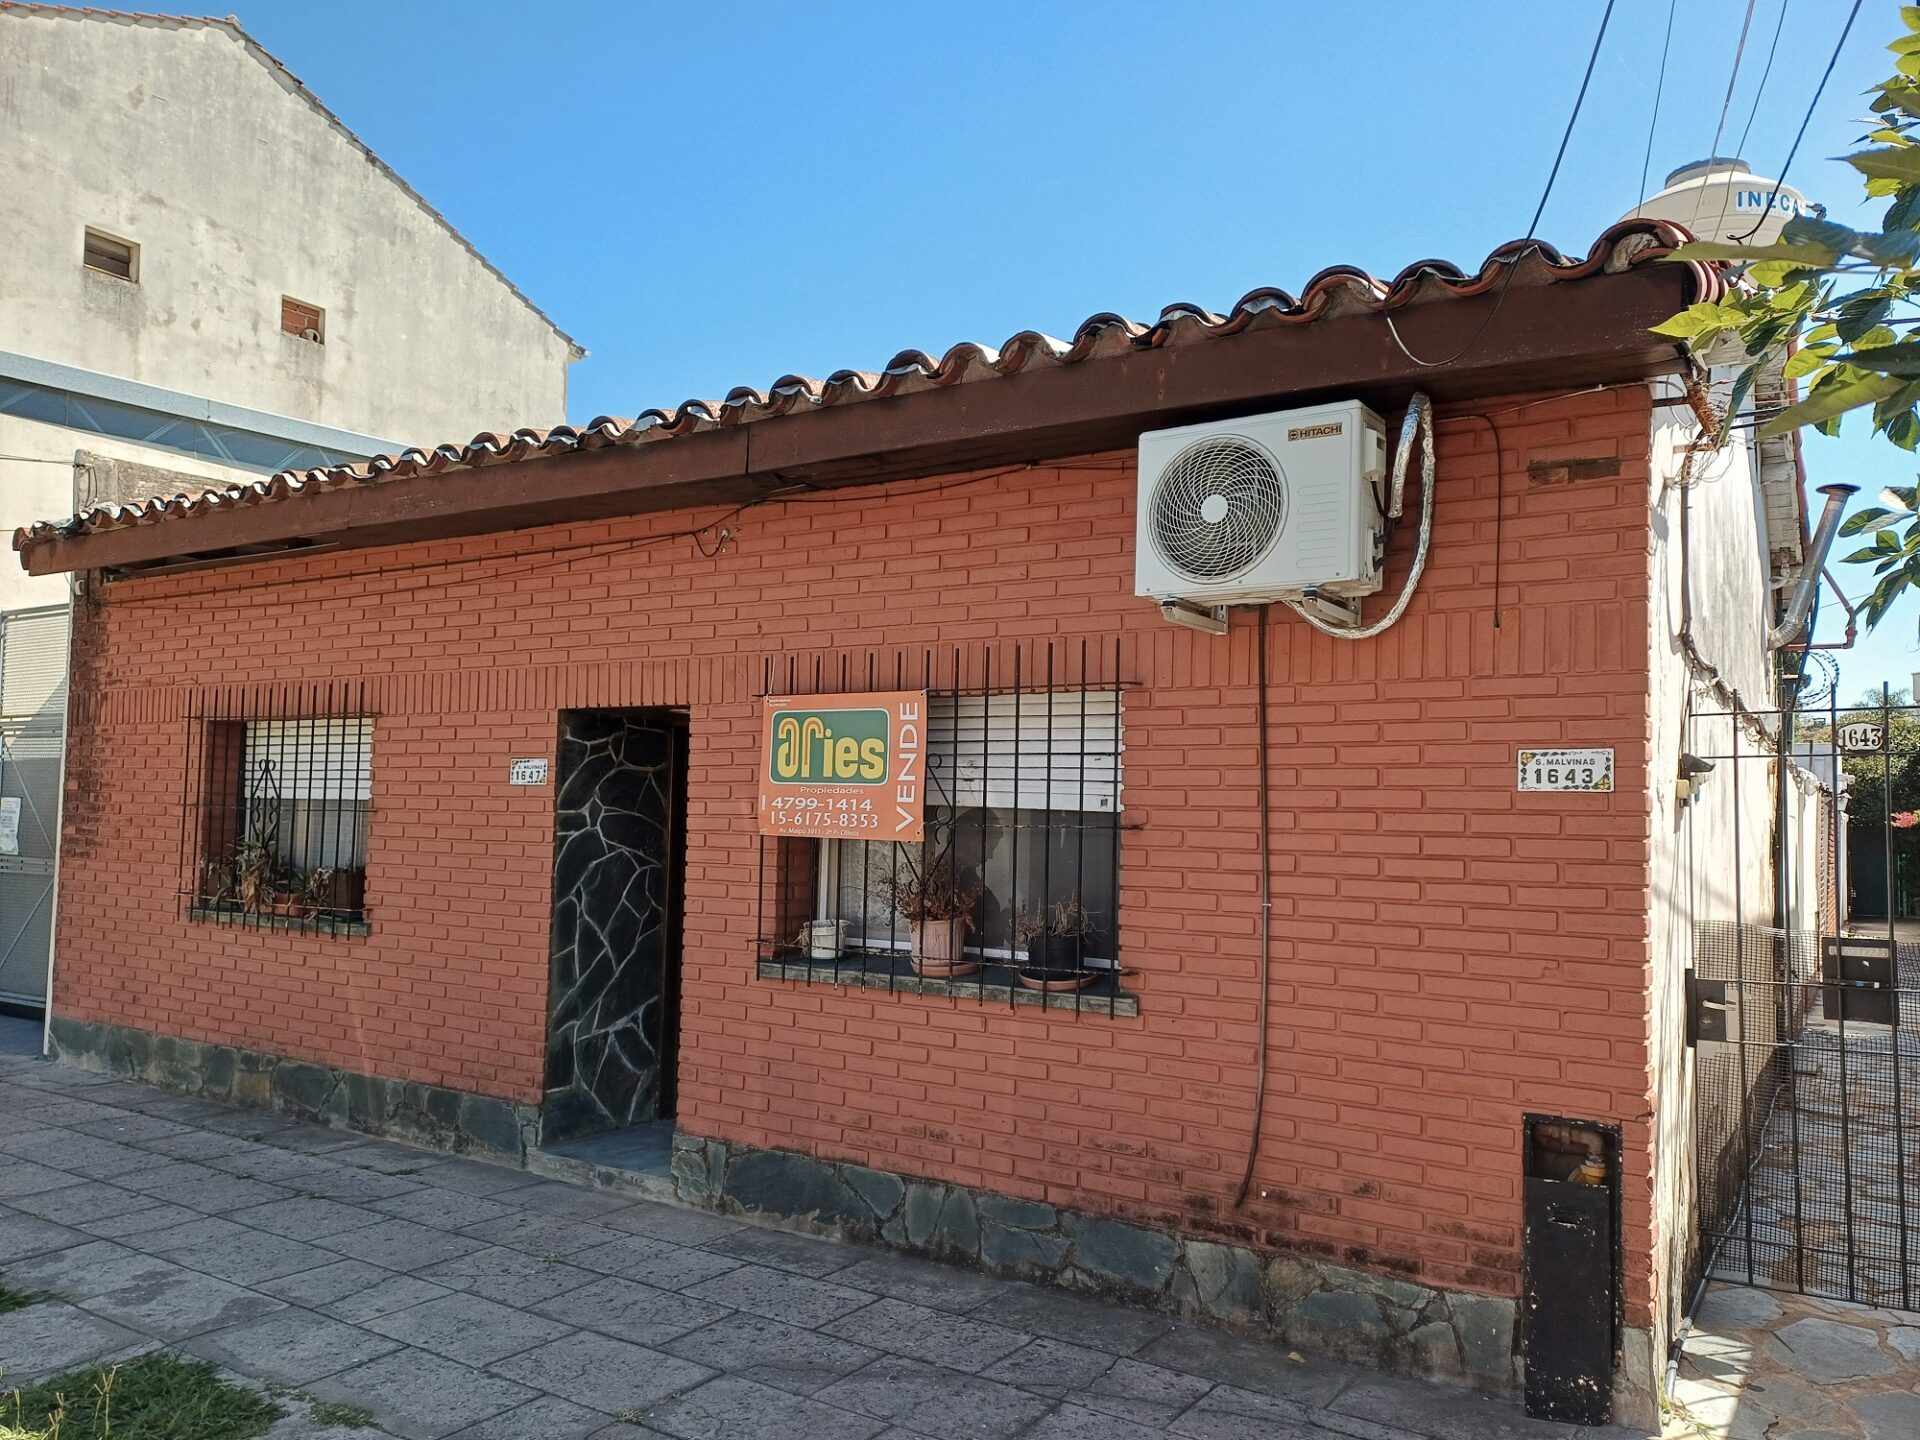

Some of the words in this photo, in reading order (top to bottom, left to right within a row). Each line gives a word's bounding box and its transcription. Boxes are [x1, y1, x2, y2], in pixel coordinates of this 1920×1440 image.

[1737, 191, 1798, 213] INECA
[1300, 425, 1342, 438] HITACHI
[1842, 728, 1881, 747] 1643
[777, 716, 885, 779] aries
[516, 770, 541, 780] 1647
[896, 702, 918, 832] VENDE
[1534, 768, 1593, 784] 1643
[800, 786, 864, 795] Propiedades
[771, 797, 873, 811] 4799-1414
[771, 811, 878, 828] 15-6175-8353
